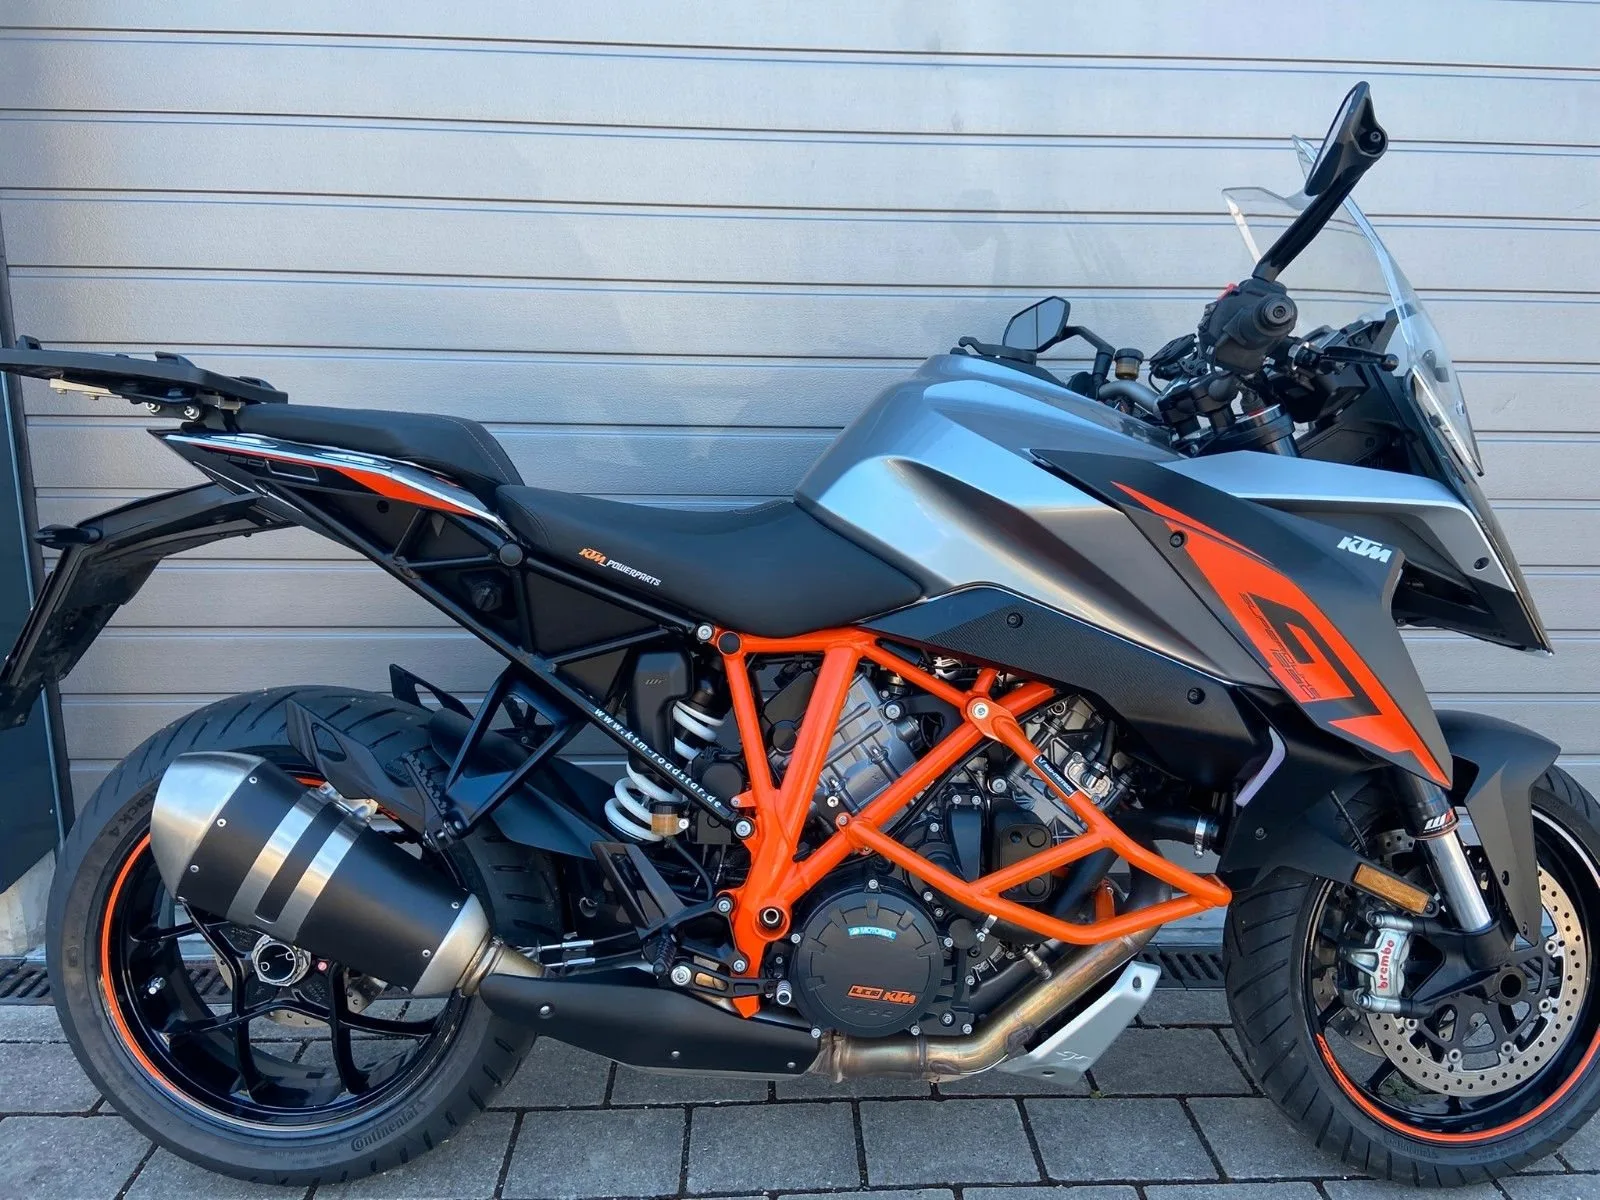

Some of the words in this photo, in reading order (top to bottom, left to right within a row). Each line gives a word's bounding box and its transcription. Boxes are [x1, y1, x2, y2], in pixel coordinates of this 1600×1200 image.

[578, 547, 606, 567] KTM
[606, 559, 661, 586] POWERPARTS
[1337, 535, 1392, 563] KTM
[594, 708, 722, 808] www.ktm-roadstar.de
[1377, 939, 1395, 990] brembo
[883, 990, 917, 1004] KTM
[350, 1105, 420, 1152] Continental
